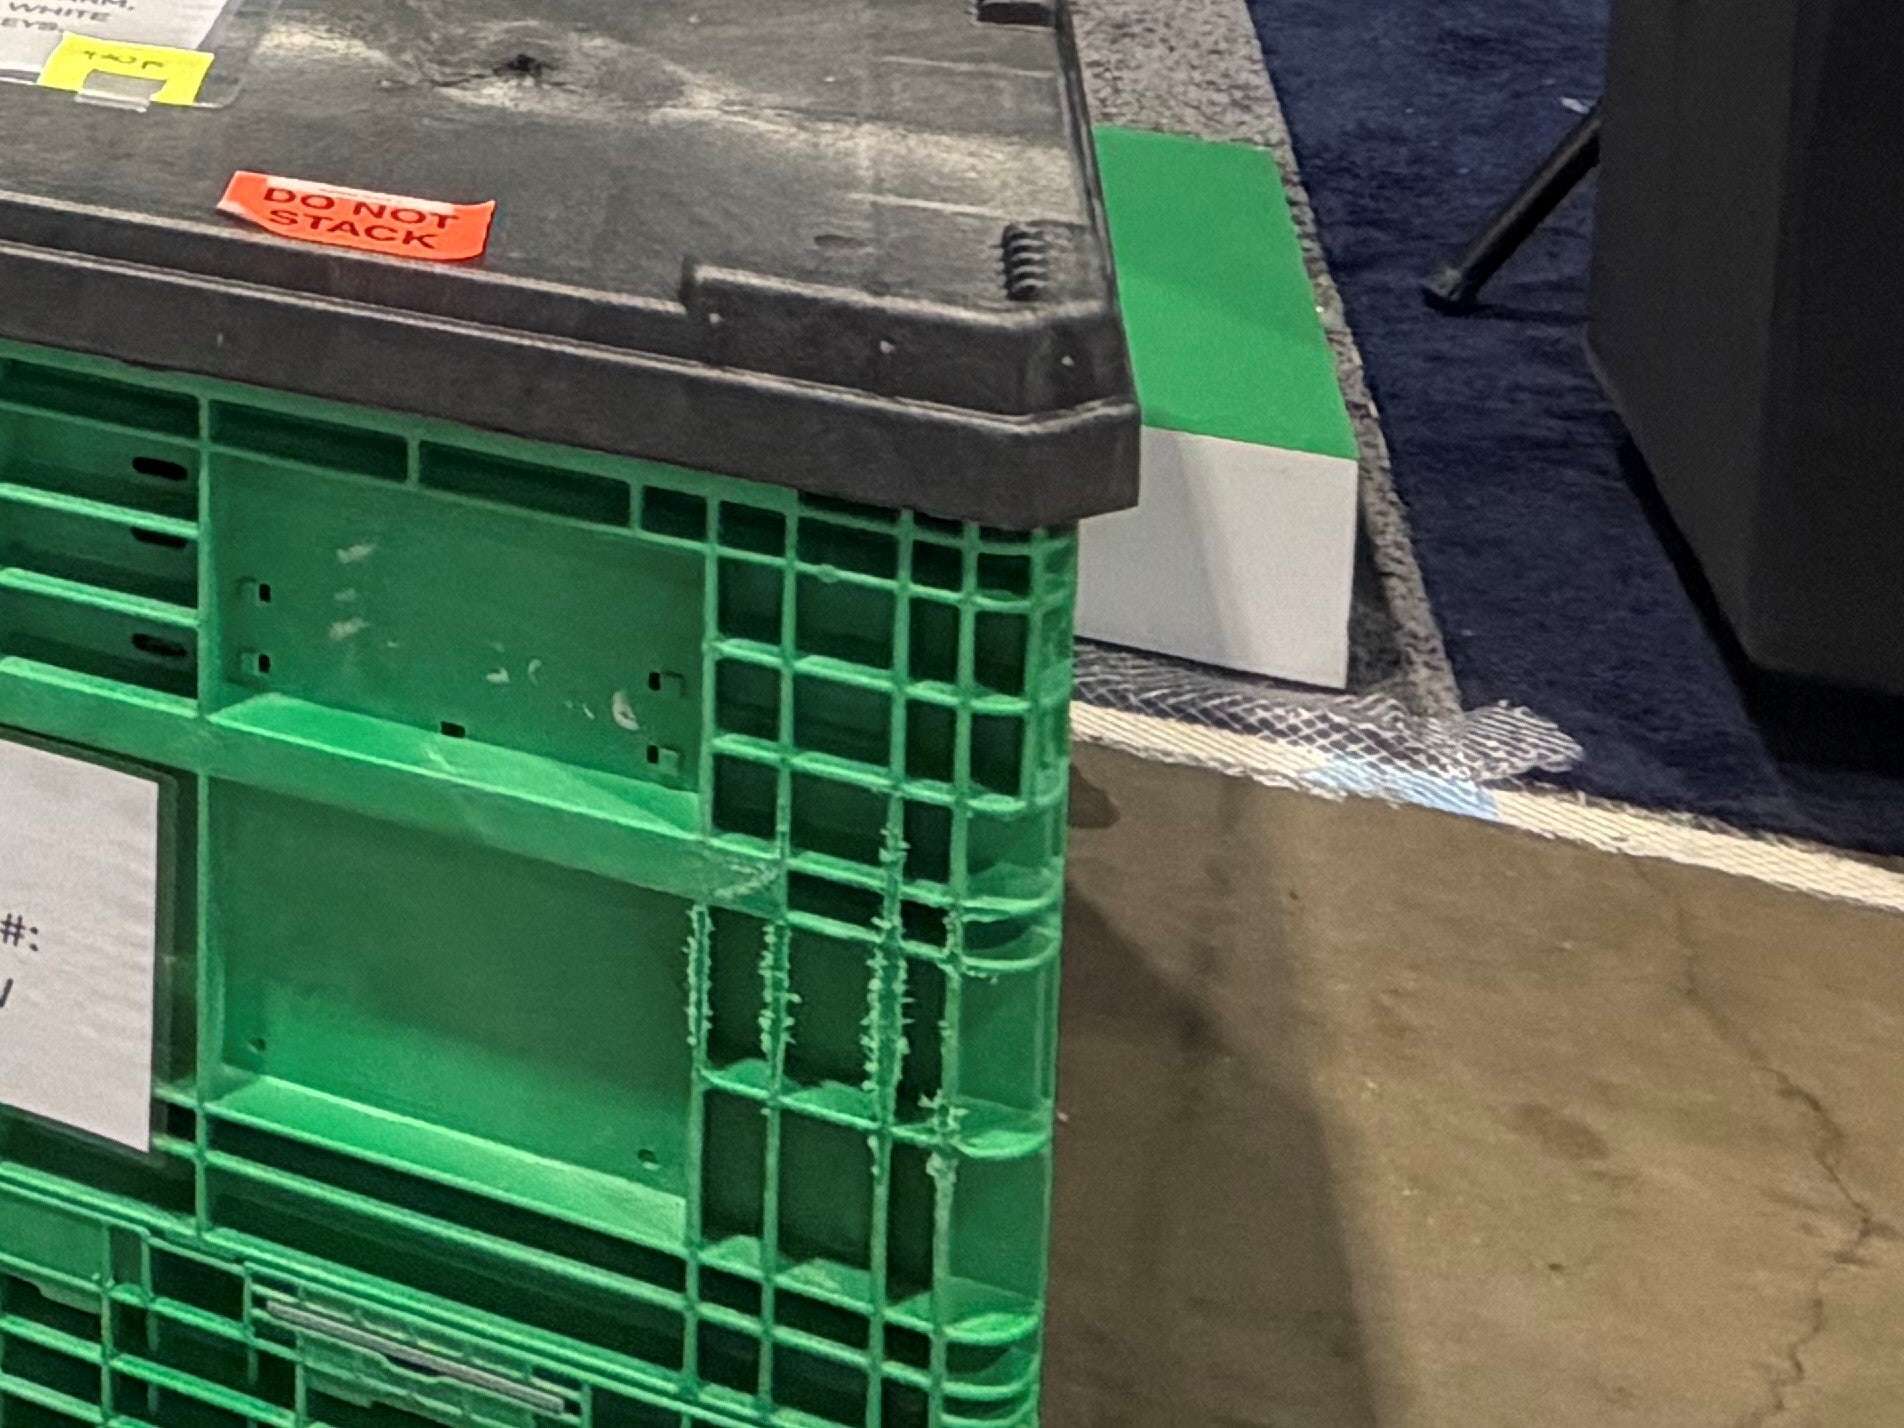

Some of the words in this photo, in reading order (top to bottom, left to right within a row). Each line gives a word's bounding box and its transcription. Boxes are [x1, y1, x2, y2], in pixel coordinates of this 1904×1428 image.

[9, 3, 112, 23] WHITE
[263, 187, 335, 210] DO
[352, 202, 460, 230] NOT
[268, 210, 438, 249] STACK
[0, 912, 39, 952] #:
